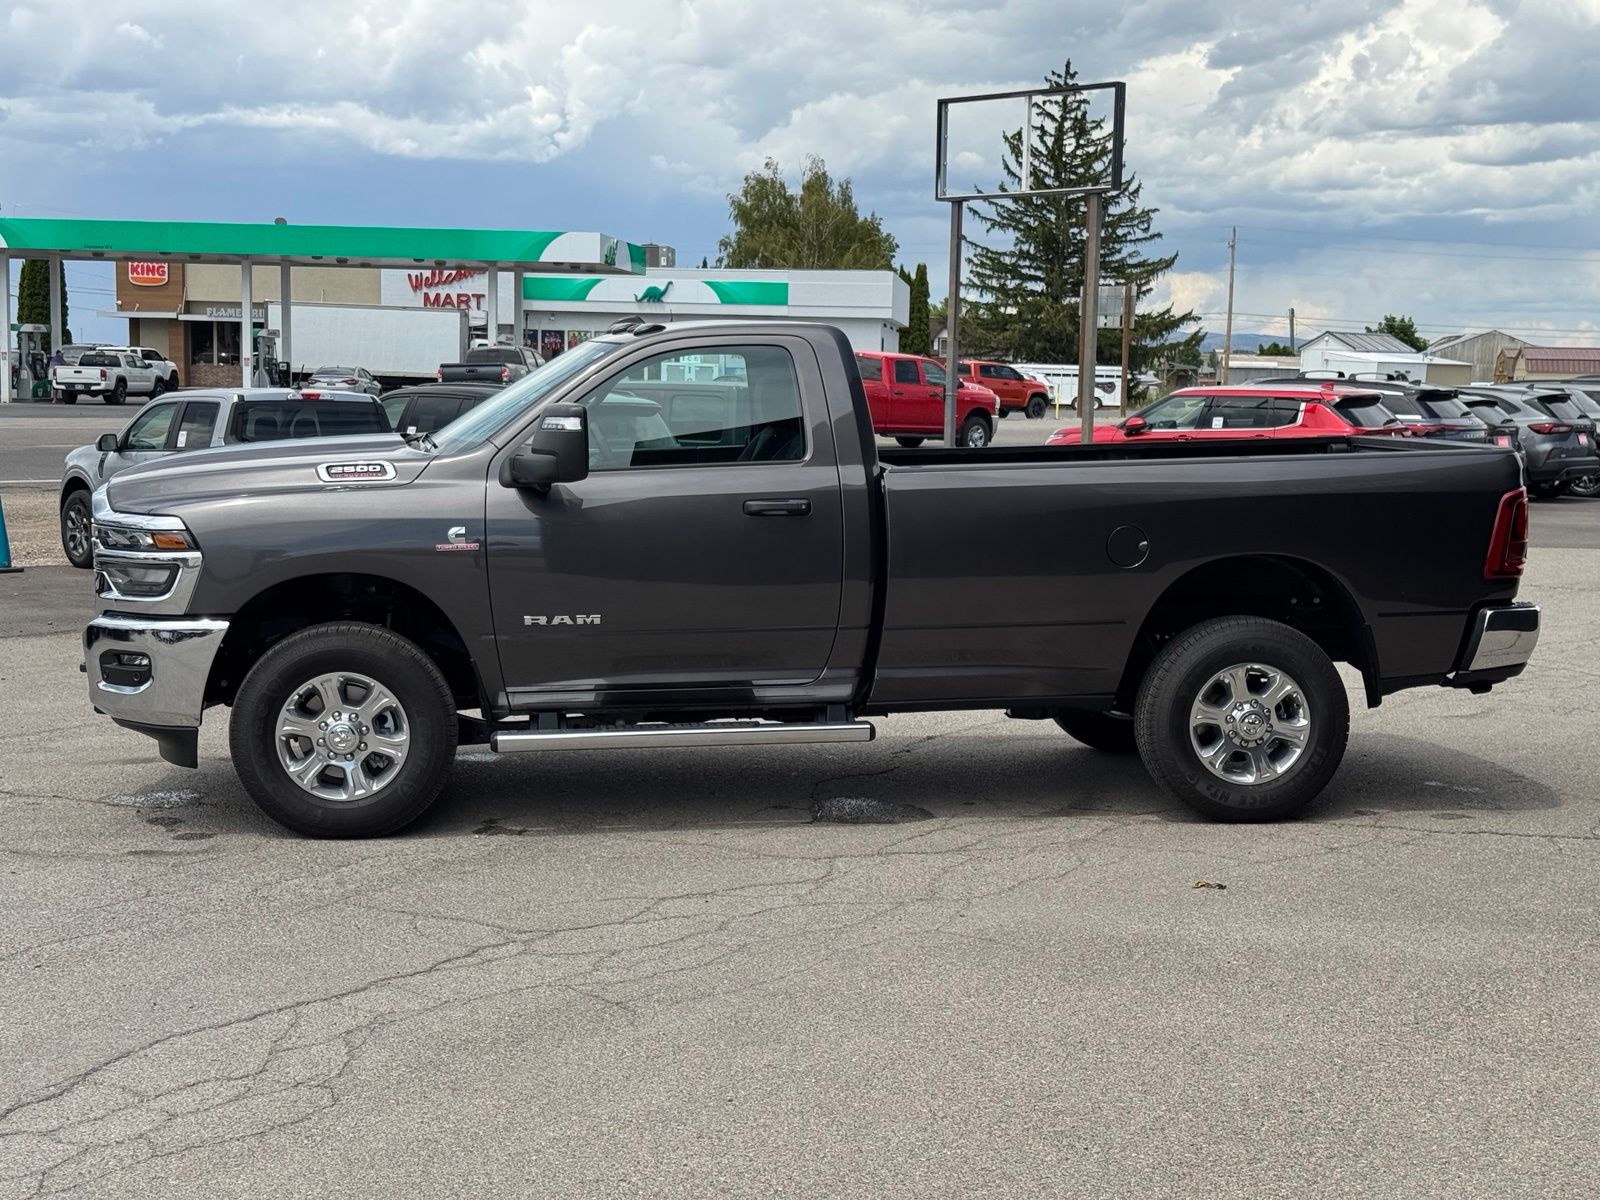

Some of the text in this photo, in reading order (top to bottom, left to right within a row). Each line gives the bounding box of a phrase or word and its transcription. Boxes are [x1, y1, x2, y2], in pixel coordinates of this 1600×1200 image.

[130, 263, 166, 276] KING
[423, 291, 487, 311] MART
[206, 307, 243, 318] FLAME
[330, 464, 381, 474] 2500
[523, 614, 602, 626] RAM
